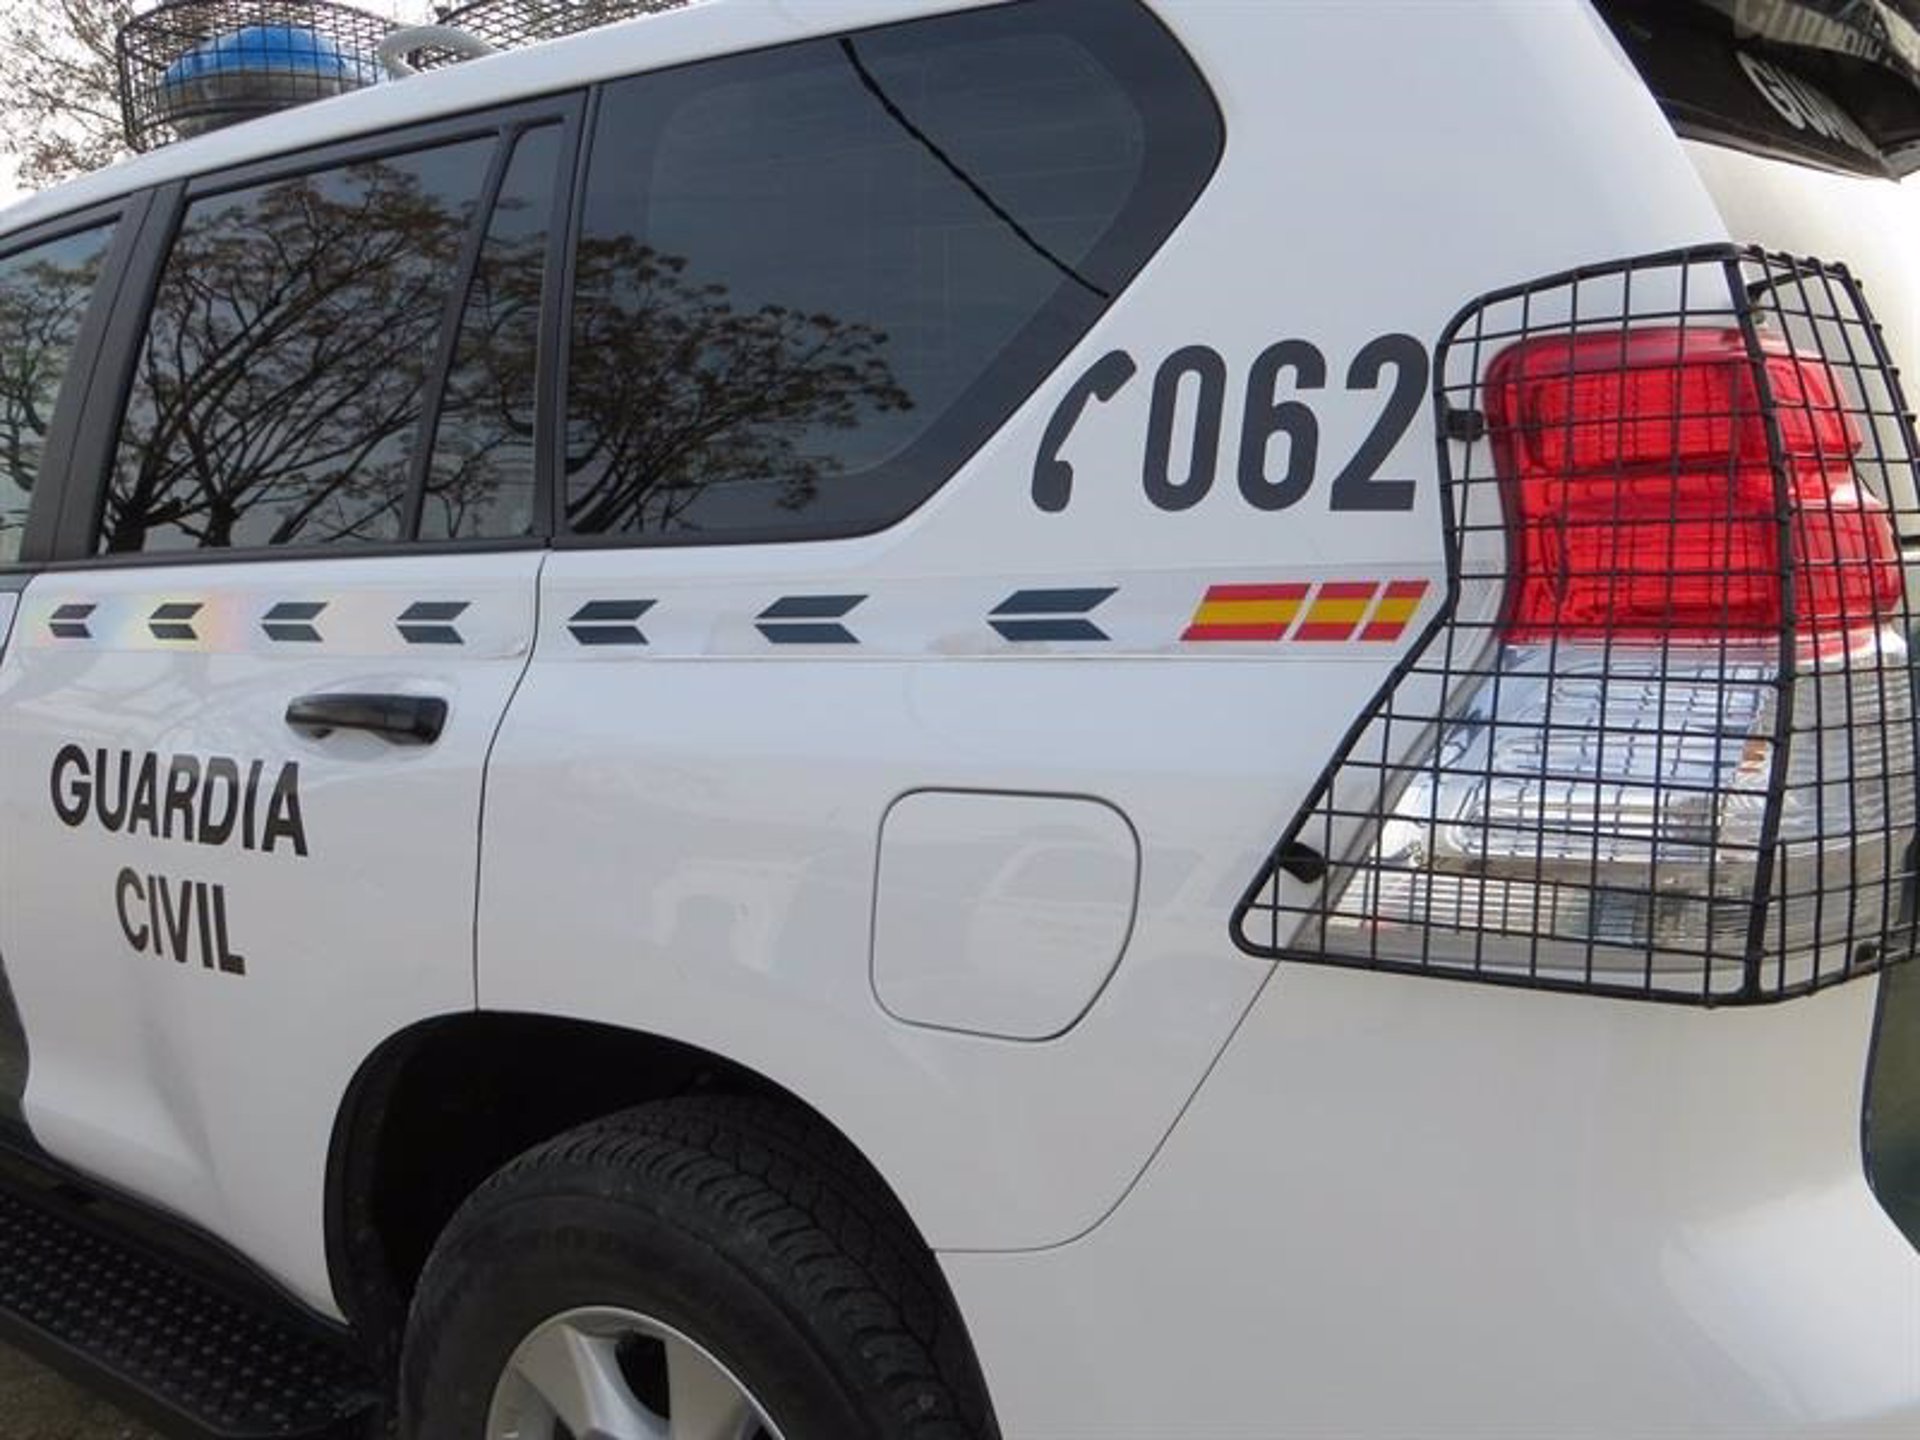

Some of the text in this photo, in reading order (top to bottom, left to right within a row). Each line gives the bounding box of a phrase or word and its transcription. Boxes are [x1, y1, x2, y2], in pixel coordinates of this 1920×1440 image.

[1143, 333, 1429, 511] 062
[50, 744, 308, 856] GUARDIA
[116, 867, 245, 975] CIVIL
